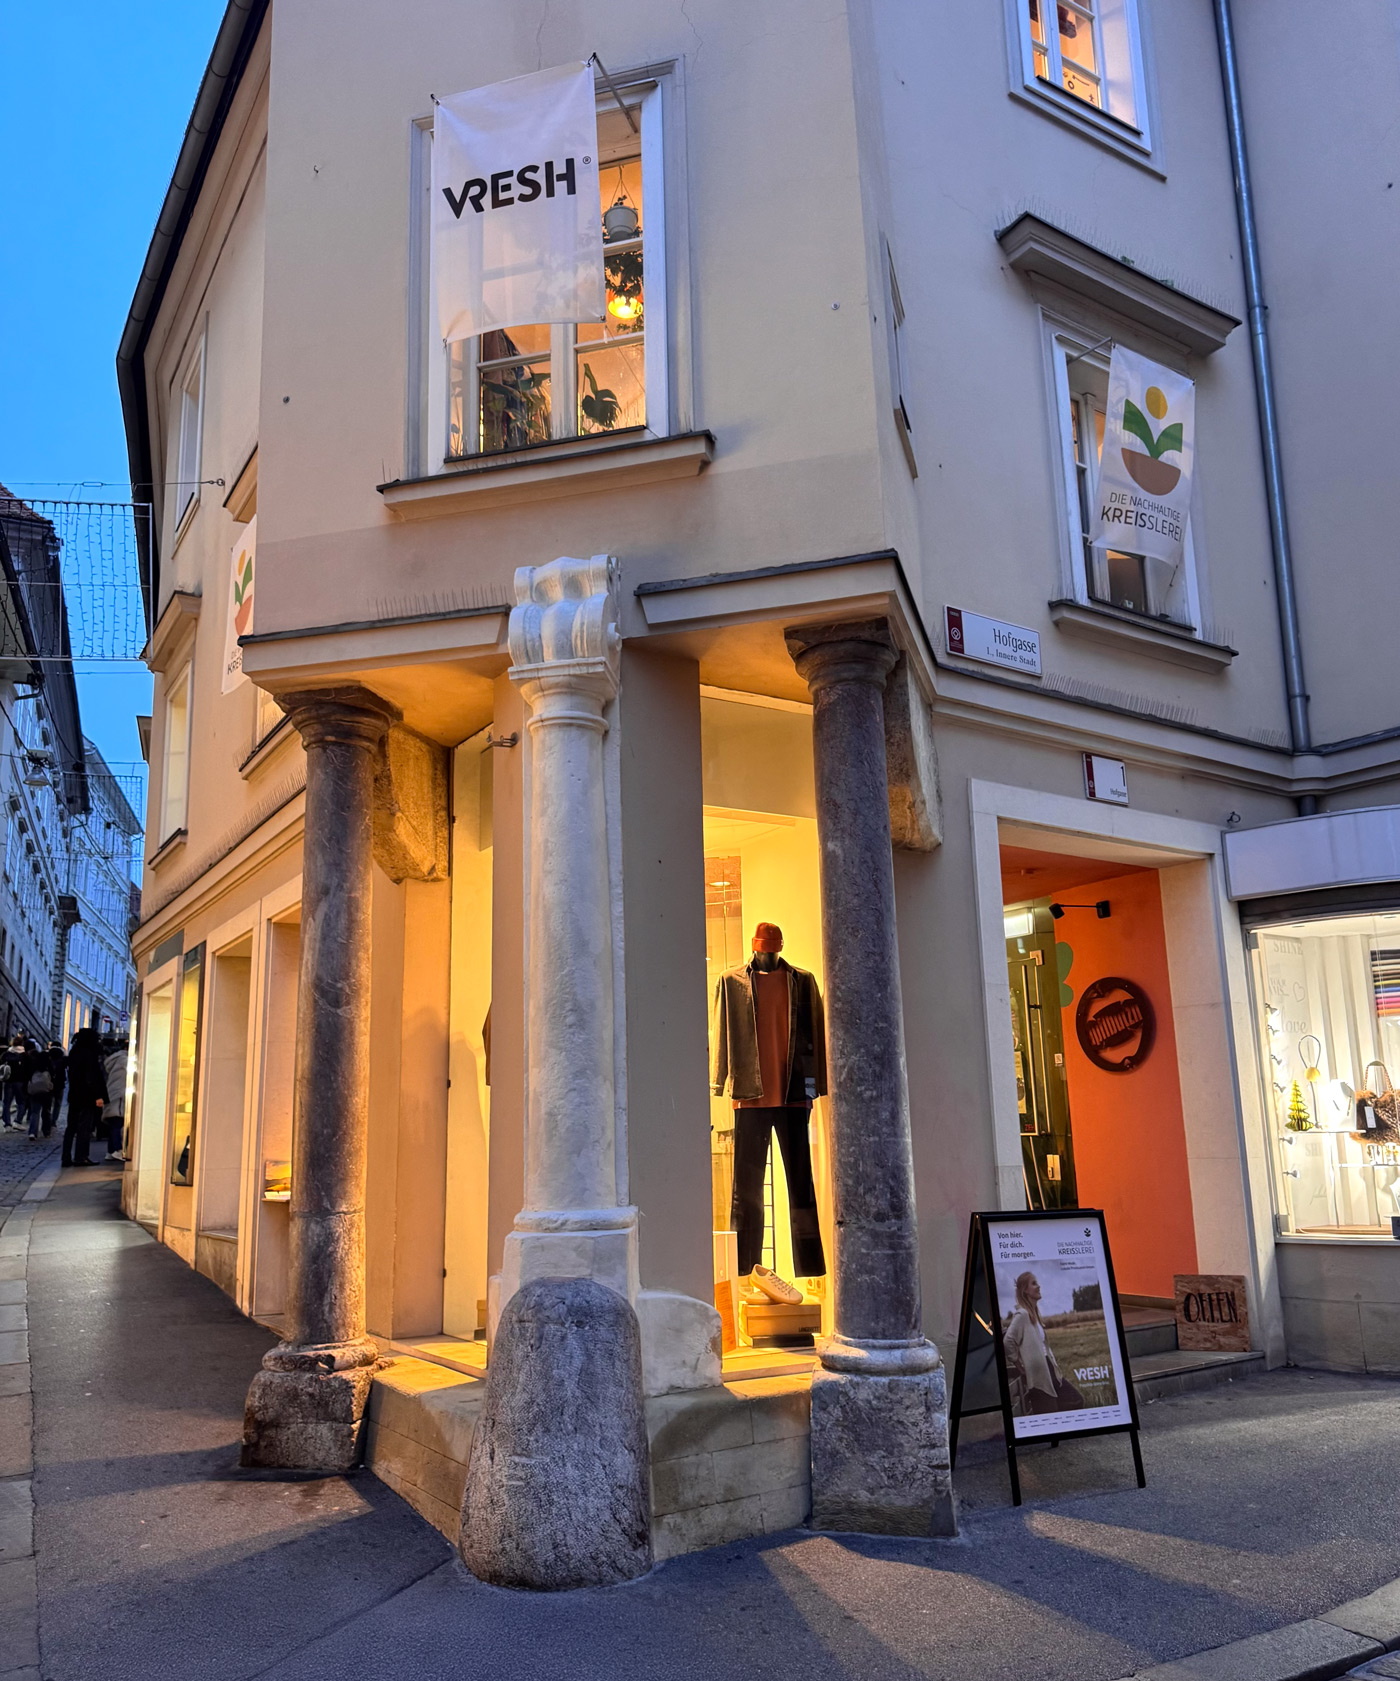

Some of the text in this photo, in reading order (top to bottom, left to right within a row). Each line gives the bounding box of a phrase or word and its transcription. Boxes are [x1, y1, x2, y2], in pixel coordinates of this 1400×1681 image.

[1110, 492, 1181, 523] DIE NACHHALTIGE
[1101, 506, 1182, 542] KREISSLEREI
[993, 628, 1037, 654] Hofgasse
[996, 648, 1017, 662] Innere
[1019, 655, 1036, 667] Stadt
[1120, 765, 1126, 787] 1
[1009, 1231, 1024, 1239] hier.
[1011, 1251, 1036, 1259] morgen.
[1058, 1247, 1095, 1255] KREISSLEREI
[1073, 1365, 1109, 1381] VRESH
